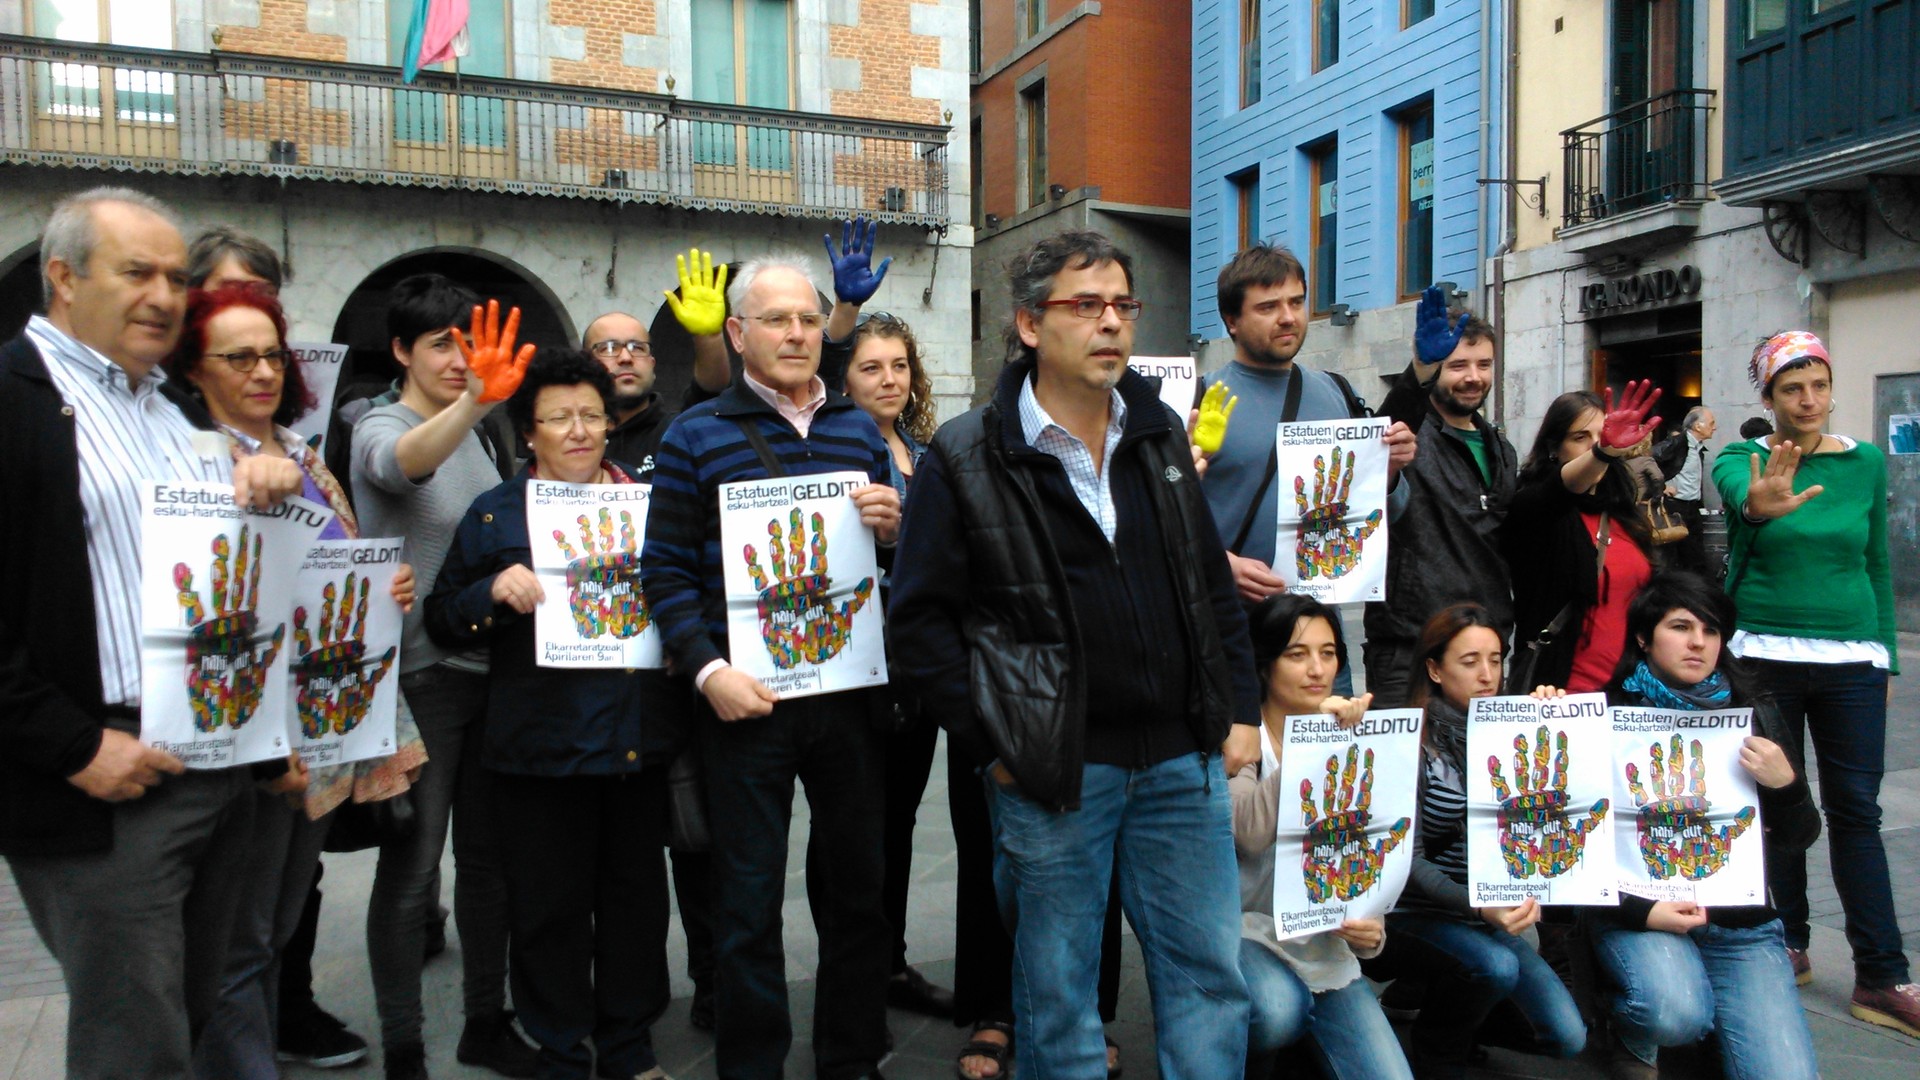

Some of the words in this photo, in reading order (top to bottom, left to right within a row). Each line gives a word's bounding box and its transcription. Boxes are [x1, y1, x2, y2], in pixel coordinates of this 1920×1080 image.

[294, 349, 342, 363] ELDITU
[1282, 425, 1331, 437] Estatuen
[1282, 436, 1332, 446] esku-hartzea
[536, 483, 596, 498] Estatuen
[727, 485, 788, 501] Estatuen
[153, 504, 243, 520] esku-hartzea
[154, 485, 236, 506] Estatue
[247, 501, 326, 528] GDITU
[727, 498, 789, 511] esku-hartzea
[306, 546, 349, 559] atuen
[352, 547, 400, 565] GELDIT
[580, 580, 604, 595] nahi
[612, 580, 631, 595] dut
[772, 609, 796, 624] nahi
[805, 604, 824, 621] dut
[545, 641, 621, 652] Elkarretaratzeak
[545, 651, 594, 663] Apirilaren
[1476, 701, 1536, 713] Estatuen
[1541, 702, 1605, 719] GELDITU
[1475, 713, 1537, 723] esku-hartzea
[1613, 710, 1672, 723] Estatuen
[1676, 715, 1748, 729] GELDITU
[1353, 718, 1419, 737] GELDITU
[1612, 722, 1671, 732] esku-hartzea
[1290, 733, 1349, 744] esku-hartzea
[1511, 821, 1534, 835] nahi
[1543, 819, 1561, 835] dut
[1650, 823, 1674, 838] nahi
[1682, 824, 1703, 839] dut
[1314, 844, 1335, 859] nahi
[1342, 840, 1360, 857] dut
[1477, 882, 1548, 892] Elkarretaratzeak
[1476, 892, 1524, 904] Apirilaren
[1281, 905, 1345, 922] Elkarretaratzeak
[1282, 919, 1321, 935] Apirilaren
[1322, 915, 1337, 926] 9an
